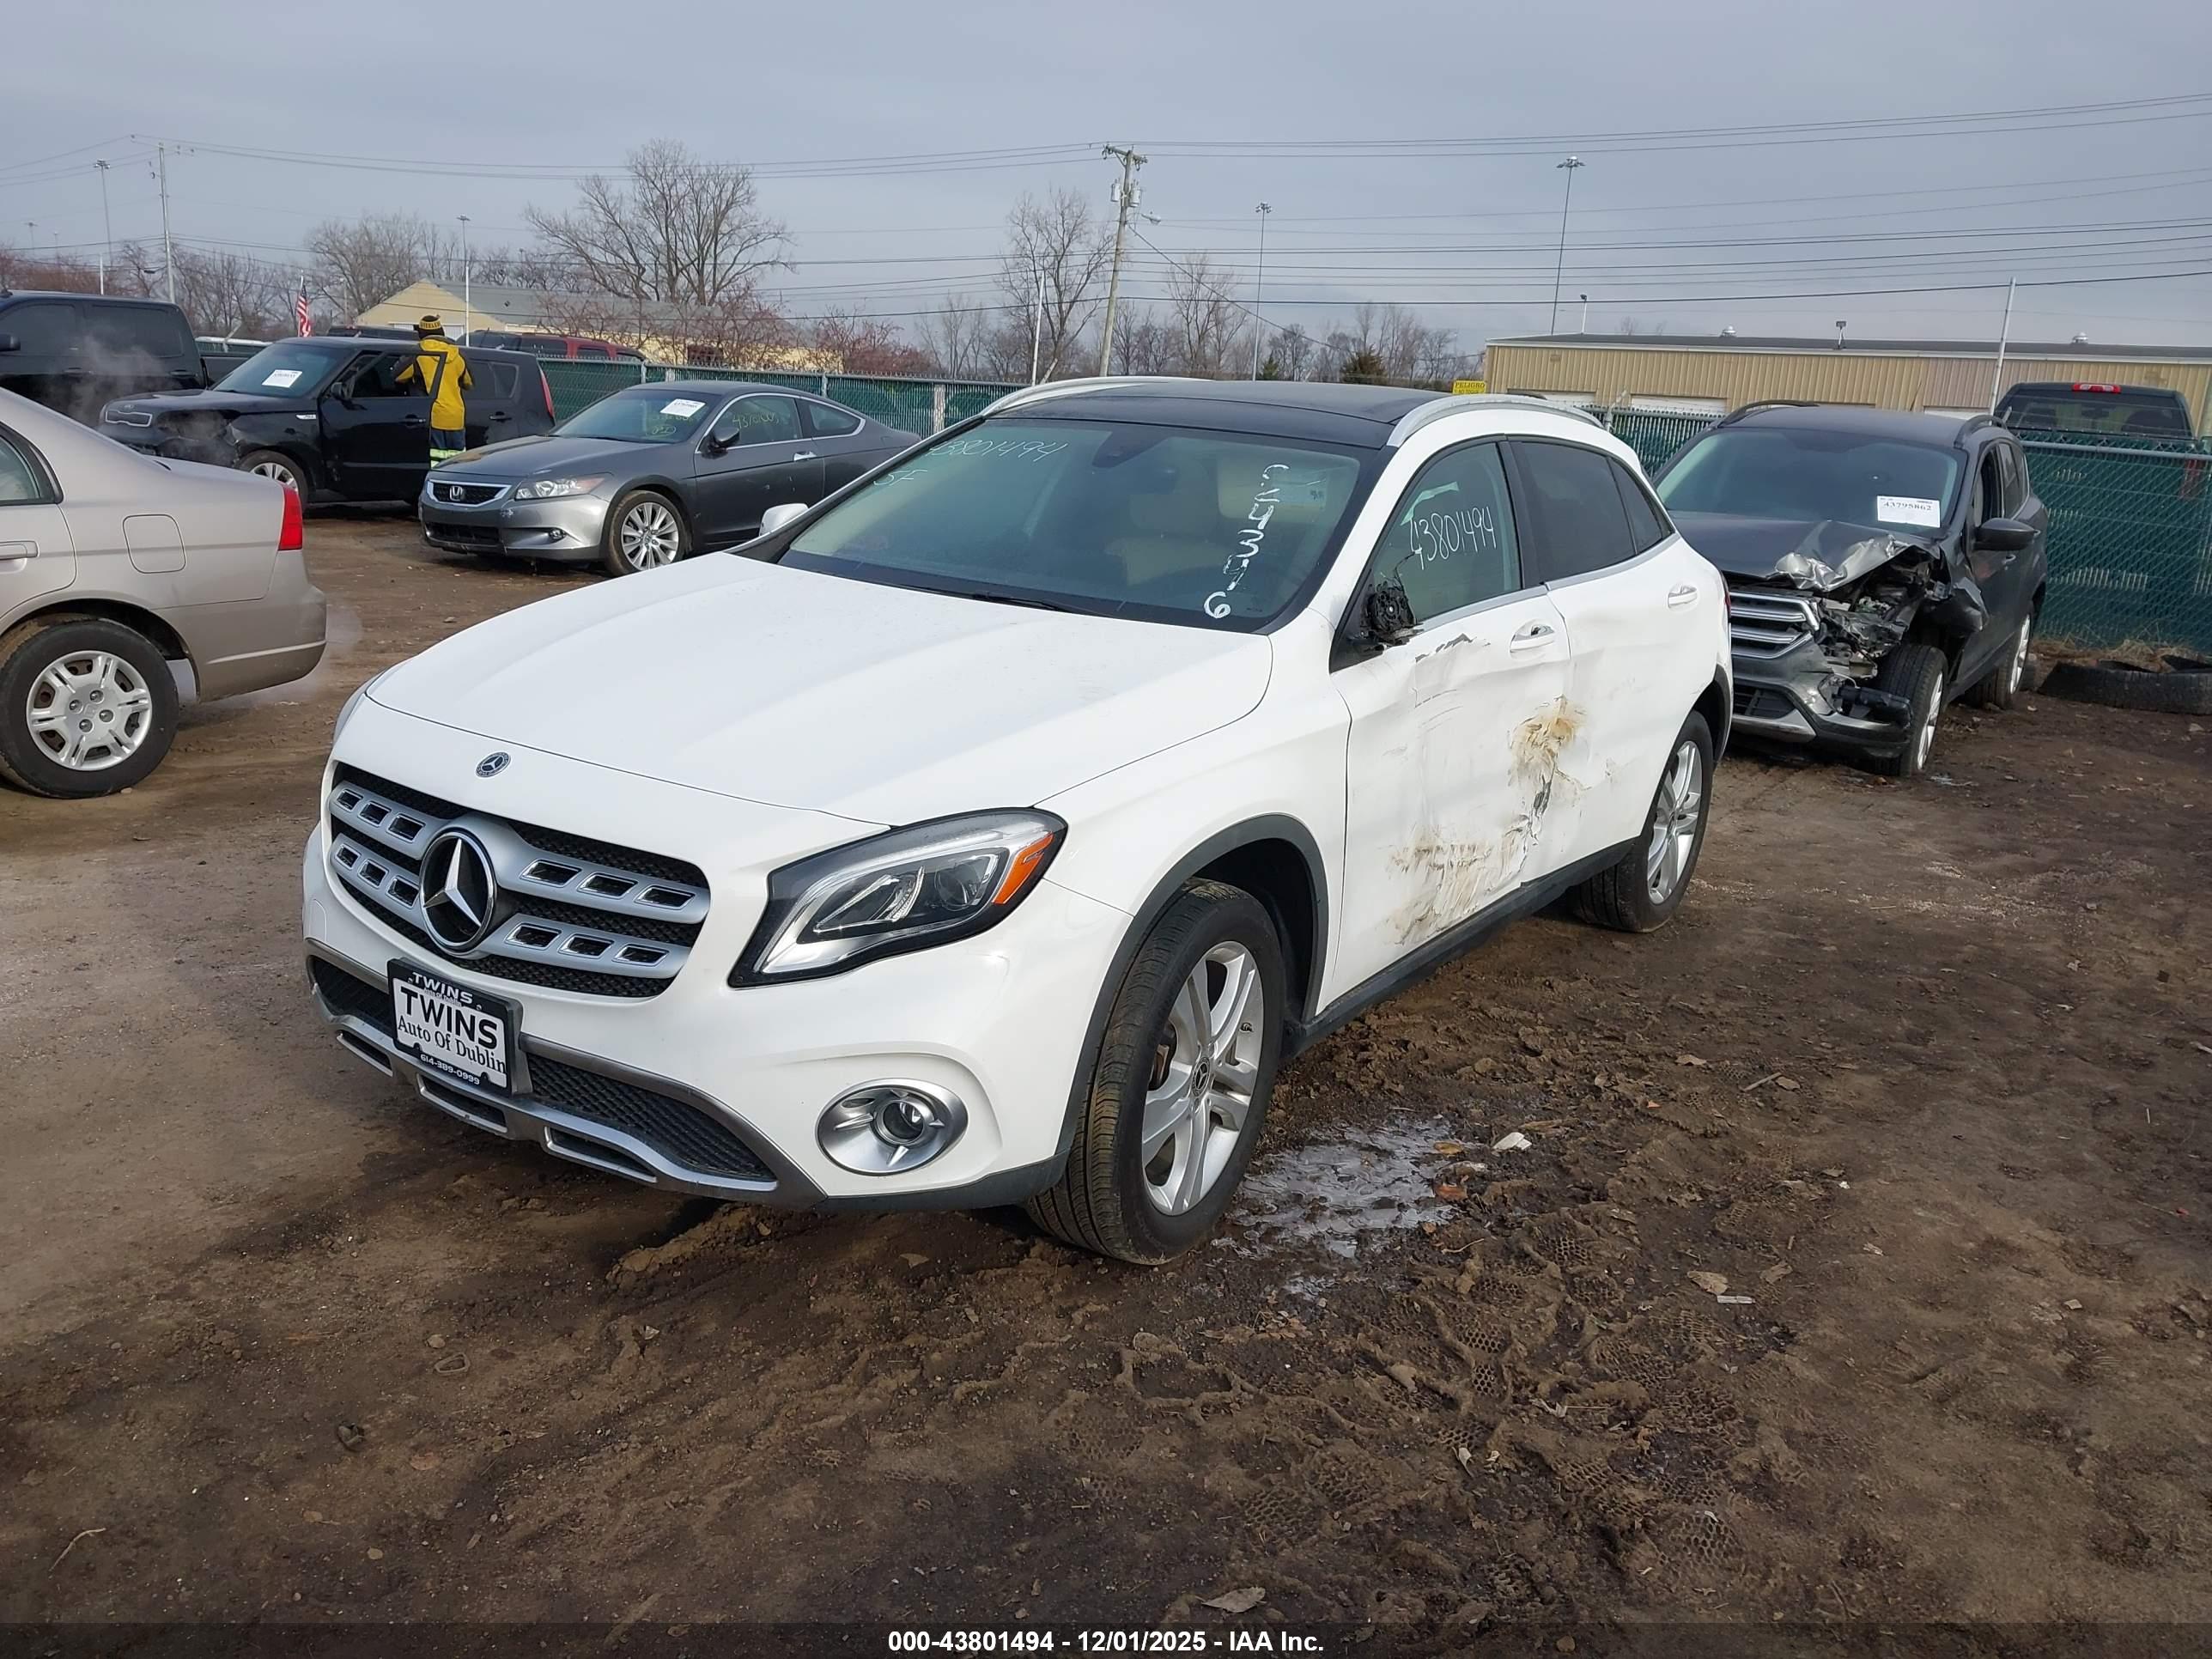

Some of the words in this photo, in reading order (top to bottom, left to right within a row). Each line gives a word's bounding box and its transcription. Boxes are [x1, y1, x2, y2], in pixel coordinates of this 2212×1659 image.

[1410, 506, 1496, 571] 43801494
[412, 971, 473, 1005] TWINS
[398, 1015, 431, 1042] Auto
[434, 1030, 452, 1052] Of
[454, 1038, 506, 1073] Dublin
[400, 986, 498, 1049] TWINS
[420, 1053, 481, 1085] 614-389-0999
